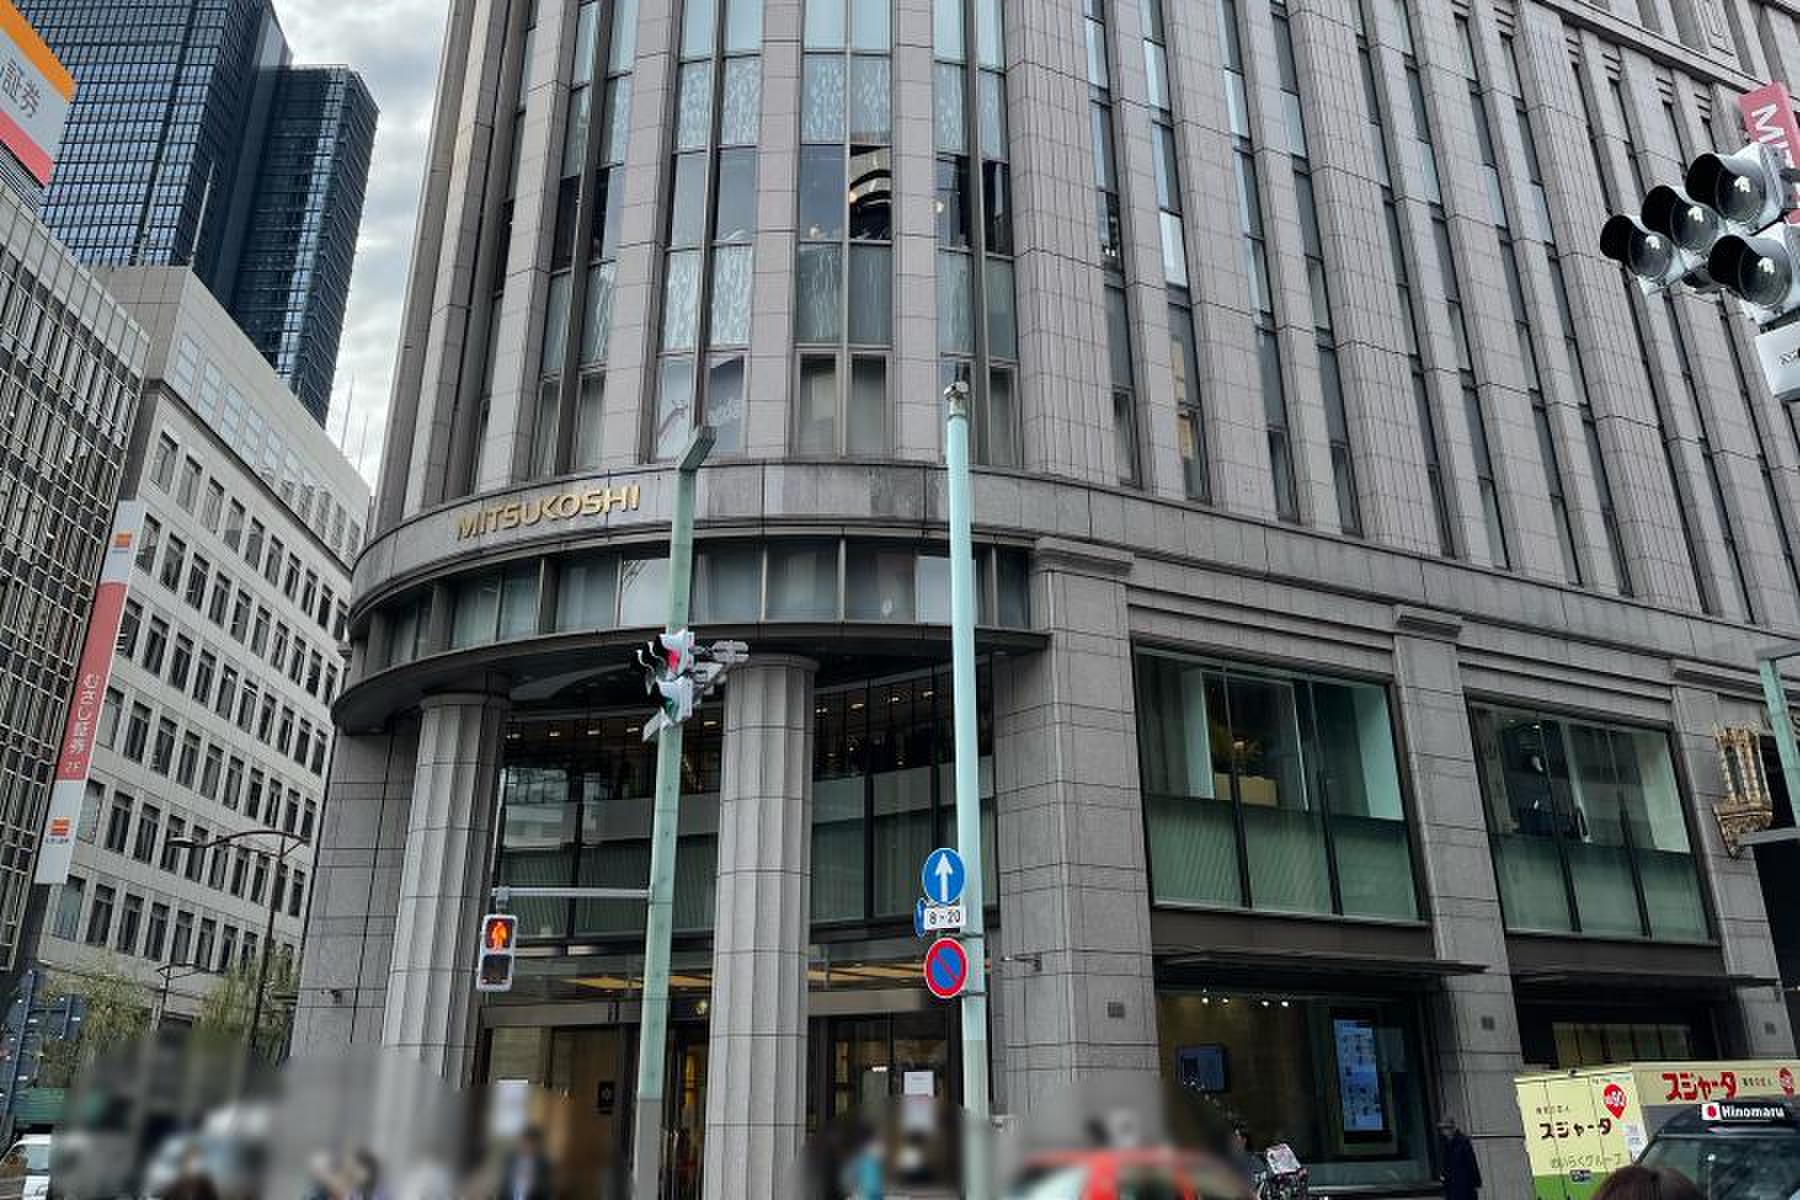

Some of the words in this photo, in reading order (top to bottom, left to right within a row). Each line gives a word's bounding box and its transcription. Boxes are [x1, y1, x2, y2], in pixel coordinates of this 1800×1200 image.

[0, 58, 41, 118] 証券
[456, 482, 641, 541] MITSUKOSHI
[1662, 1071, 1737, 1101] スジャータ
[1721, 1105, 1785, 1118] Hinomaru
[1539, 1117, 1612, 1140] スジャータ
